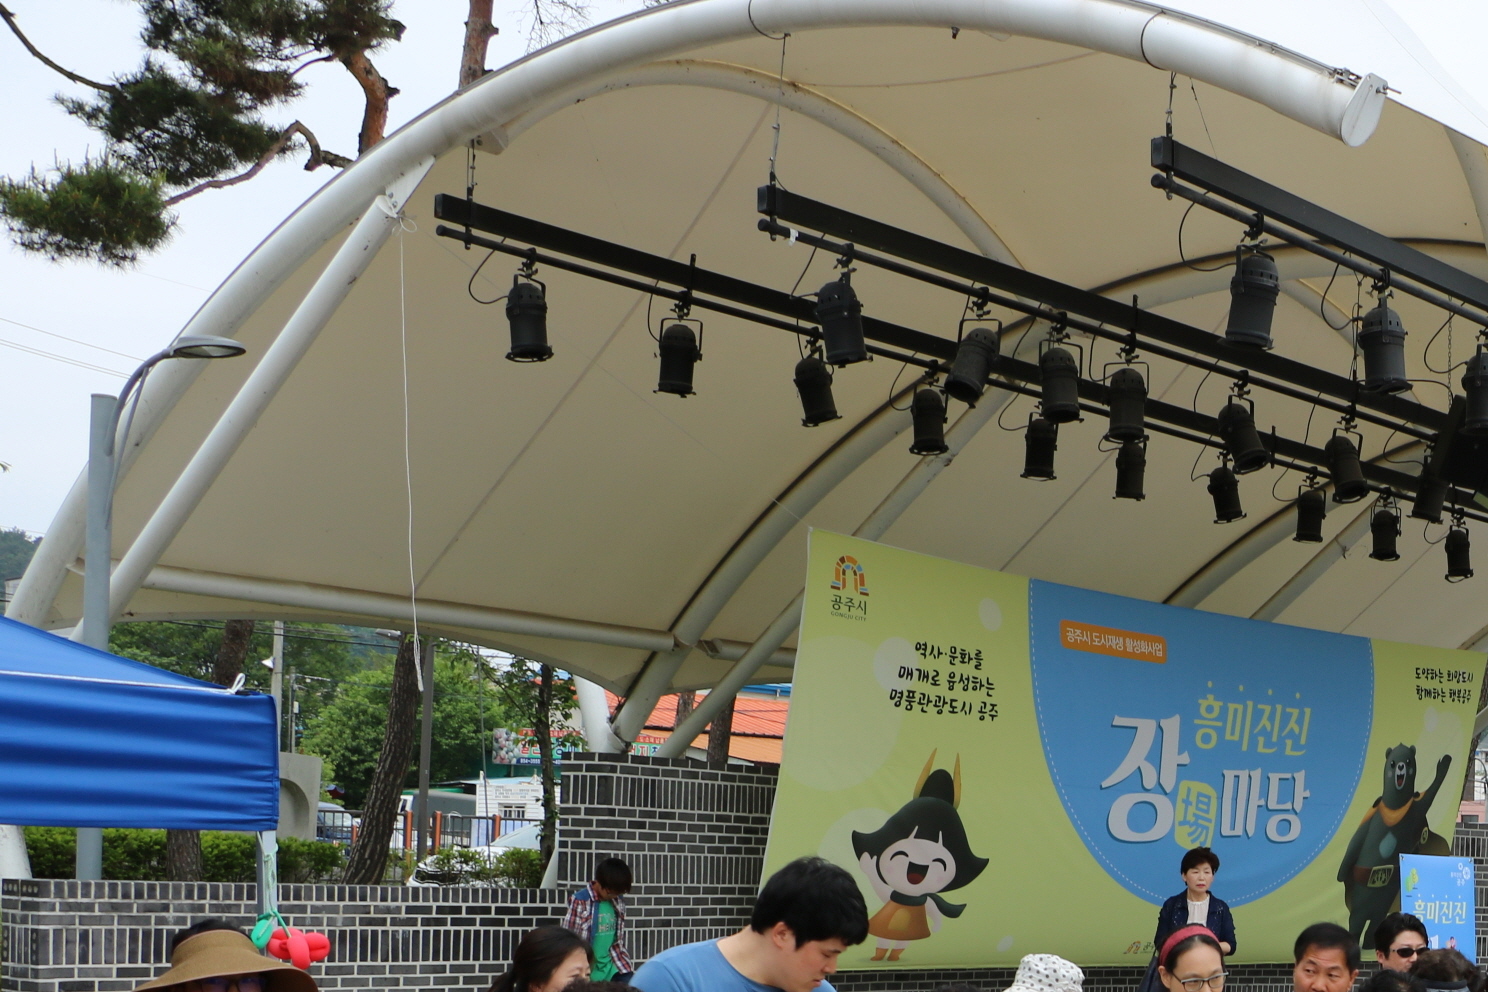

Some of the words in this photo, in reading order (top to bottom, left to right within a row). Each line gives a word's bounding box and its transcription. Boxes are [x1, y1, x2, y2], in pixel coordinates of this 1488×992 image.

[831, 594, 867, 615] 공주시
[831, 611, 854, 620] GONGJU
[914, 641, 984, 671] 역사·문화를
[1066, 627, 1091, 645] 공주시
[1092, 632, 1124, 651] 도시재생
[1125, 637, 1163, 657] 활성화사업
[898, 665, 941, 687] 매개로
[946, 671, 995, 697] 융성하는
[1415, 667, 1444, 683] 도약하는
[1447, 670, 1474, 683] 희망도시
[889, 688, 973, 716] 명품관광도시
[977, 701, 999, 722] 공주
[1416, 684, 1447, 703] 함께하는
[1194, 692, 1311, 756] 흥미진진
[1100, 714, 1190, 843] 장
[1220, 767, 1311, 843] 마당
[1413, 899, 1467, 924] 흥미진진
